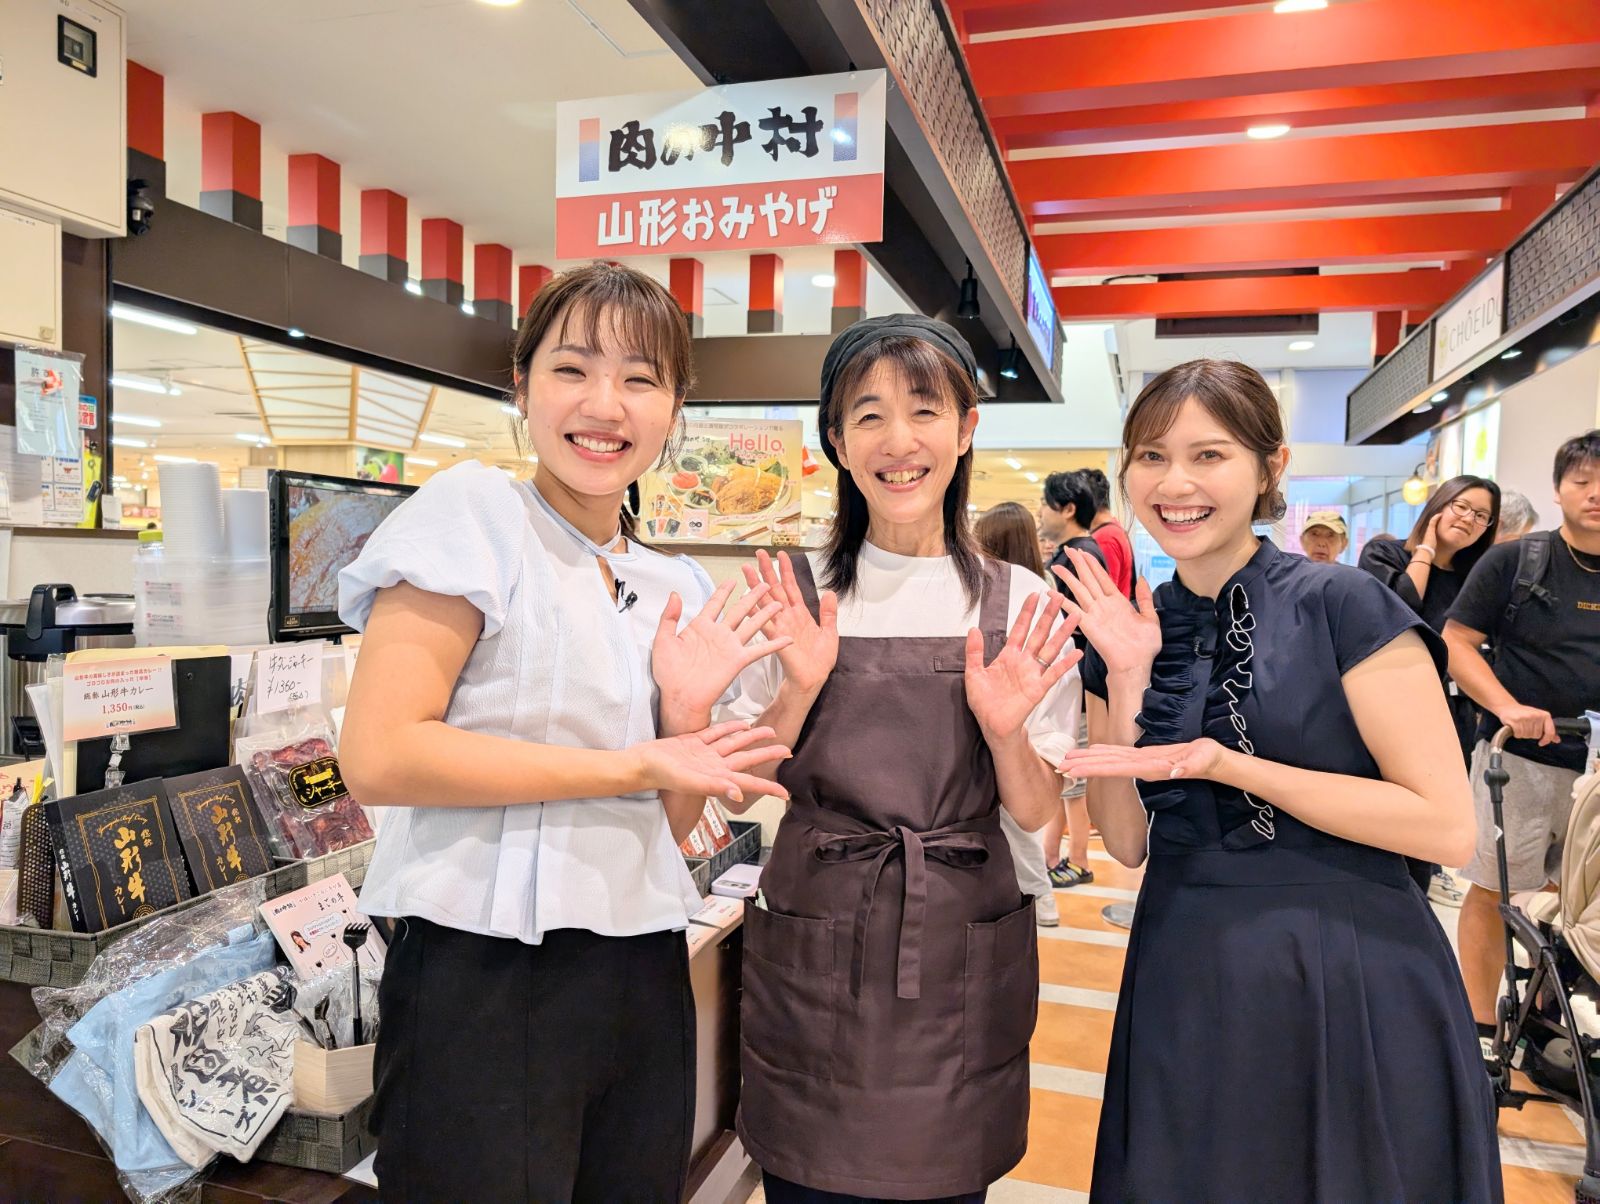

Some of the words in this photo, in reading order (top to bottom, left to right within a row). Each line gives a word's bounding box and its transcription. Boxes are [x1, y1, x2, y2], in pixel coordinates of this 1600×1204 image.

[597, 186, 838, 247] 山形おみやげ
[729, 432, 785, 453] Hello,
[101, 685, 154, 699] 山形牛カレー
[210, 804, 242, 872] 山形牛
[113, 826, 147, 903] 山形牛
[216, 855, 229, 882] カレー
[114, 885, 126, 916] カレー
